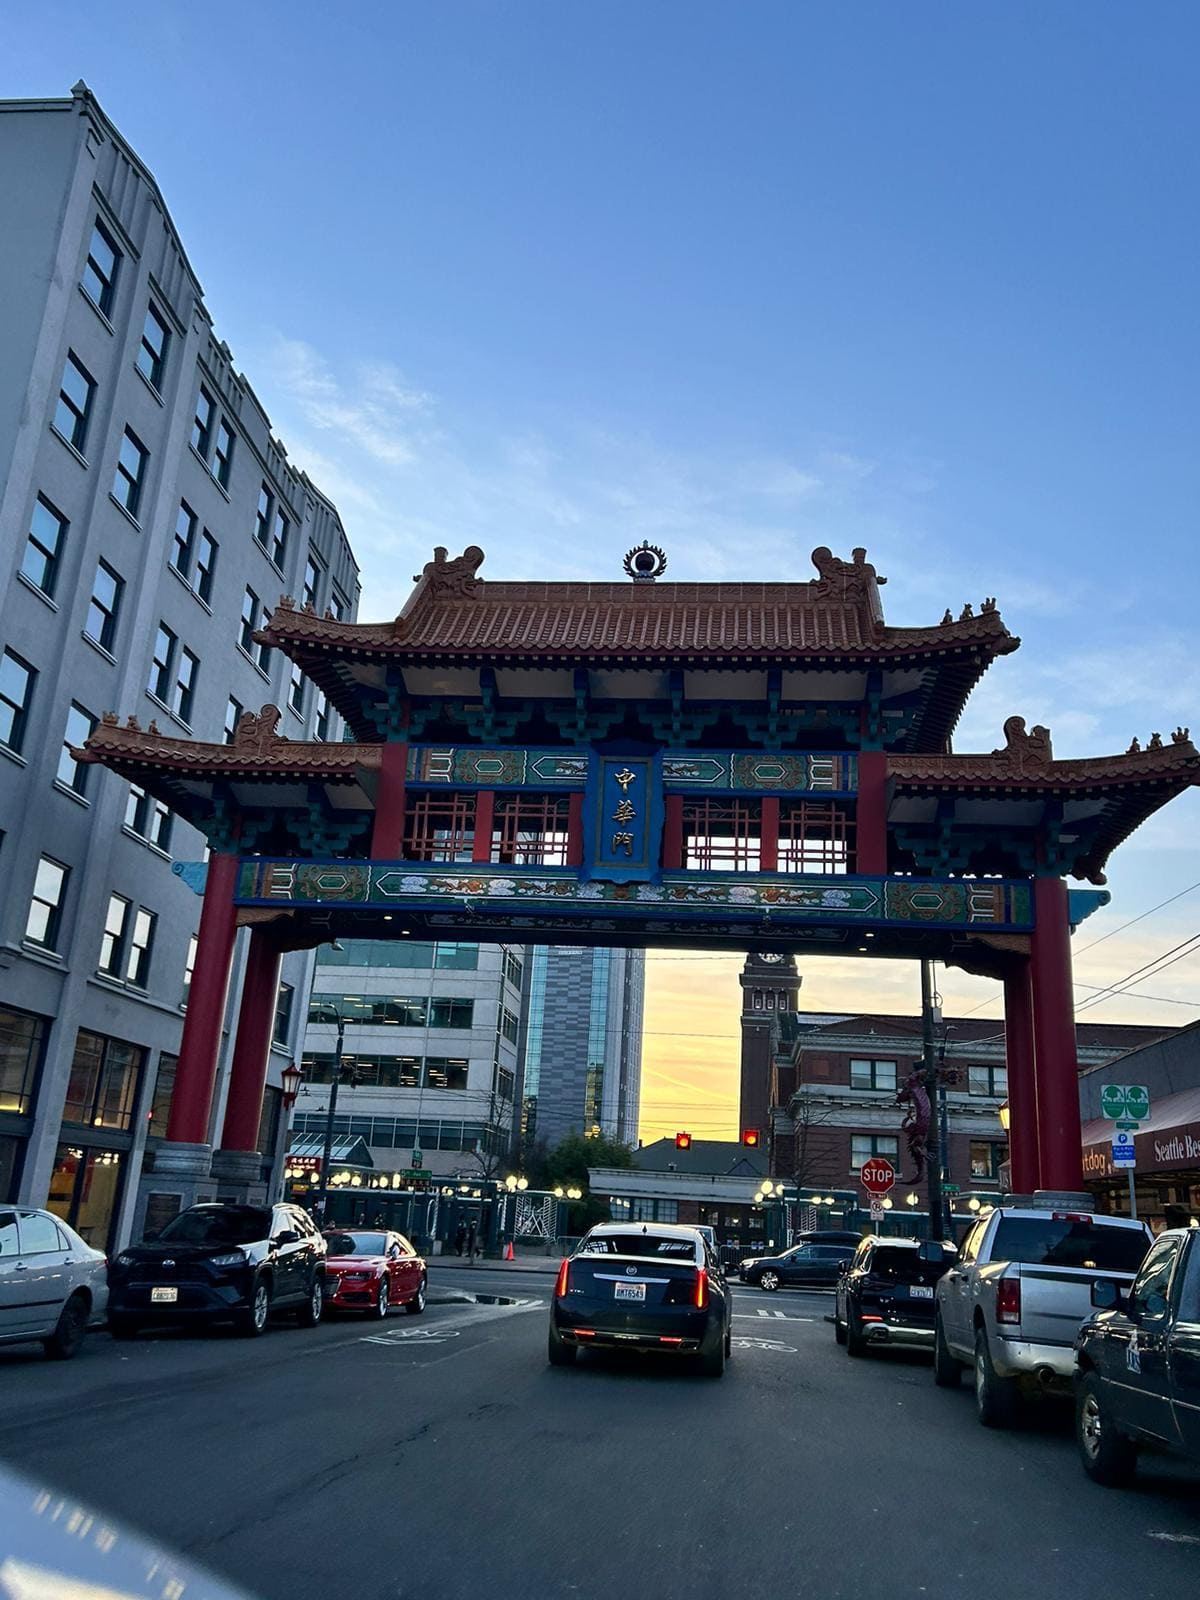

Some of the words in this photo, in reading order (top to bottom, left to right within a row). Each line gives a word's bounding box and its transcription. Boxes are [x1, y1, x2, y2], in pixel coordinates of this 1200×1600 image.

[611, 767, 637, 857] 中華門
[1154, 1135, 1184, 1162] Seattle
[863, 1168, 893, 1183] STOP
